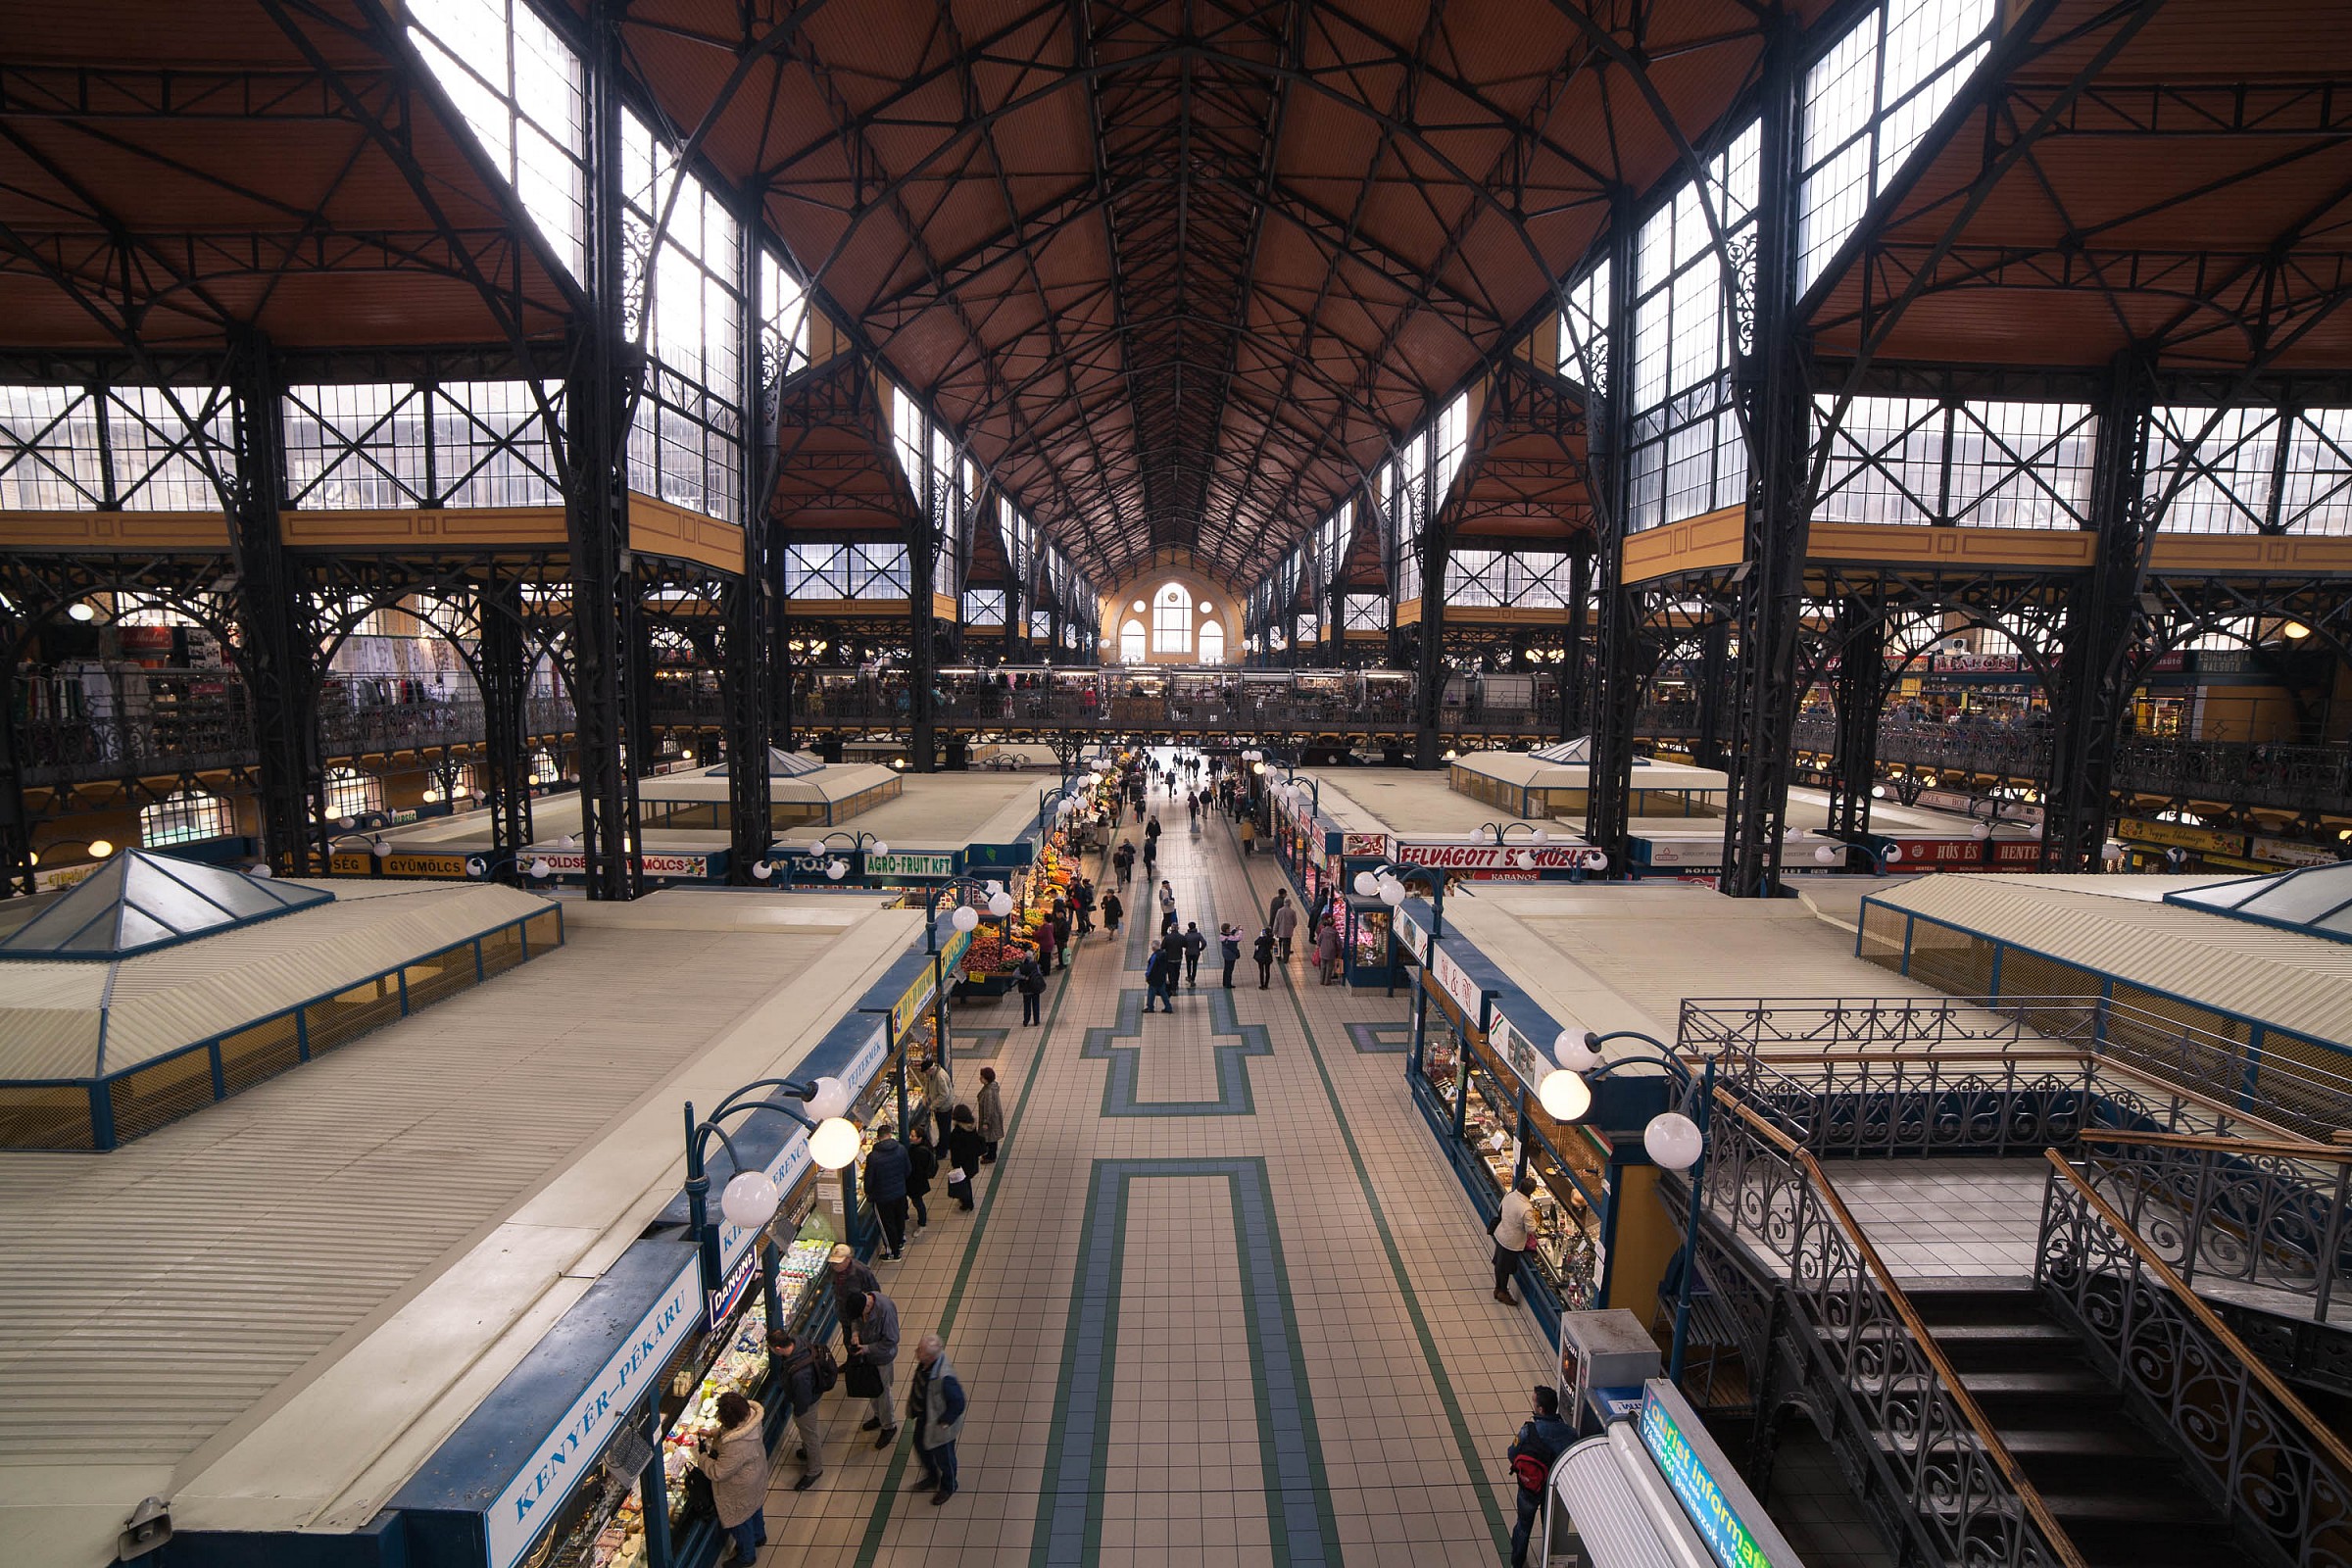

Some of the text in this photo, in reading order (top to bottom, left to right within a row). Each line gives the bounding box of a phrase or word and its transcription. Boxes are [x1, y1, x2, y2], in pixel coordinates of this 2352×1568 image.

[1401, 846, 1499, 866] FELVÁGOTT
[1936, 842, 1959, 859] HÚS
[1964, 842, 1978, 859] ÉS
[390, 858, 461, 873] GYÜMÖLCS
[867, 856, 929, 874] AGRO-FRUIT
[1646, 1388, 1690, 1469] Tourist
[1675, 1473, 1718, 1547] panaszok
